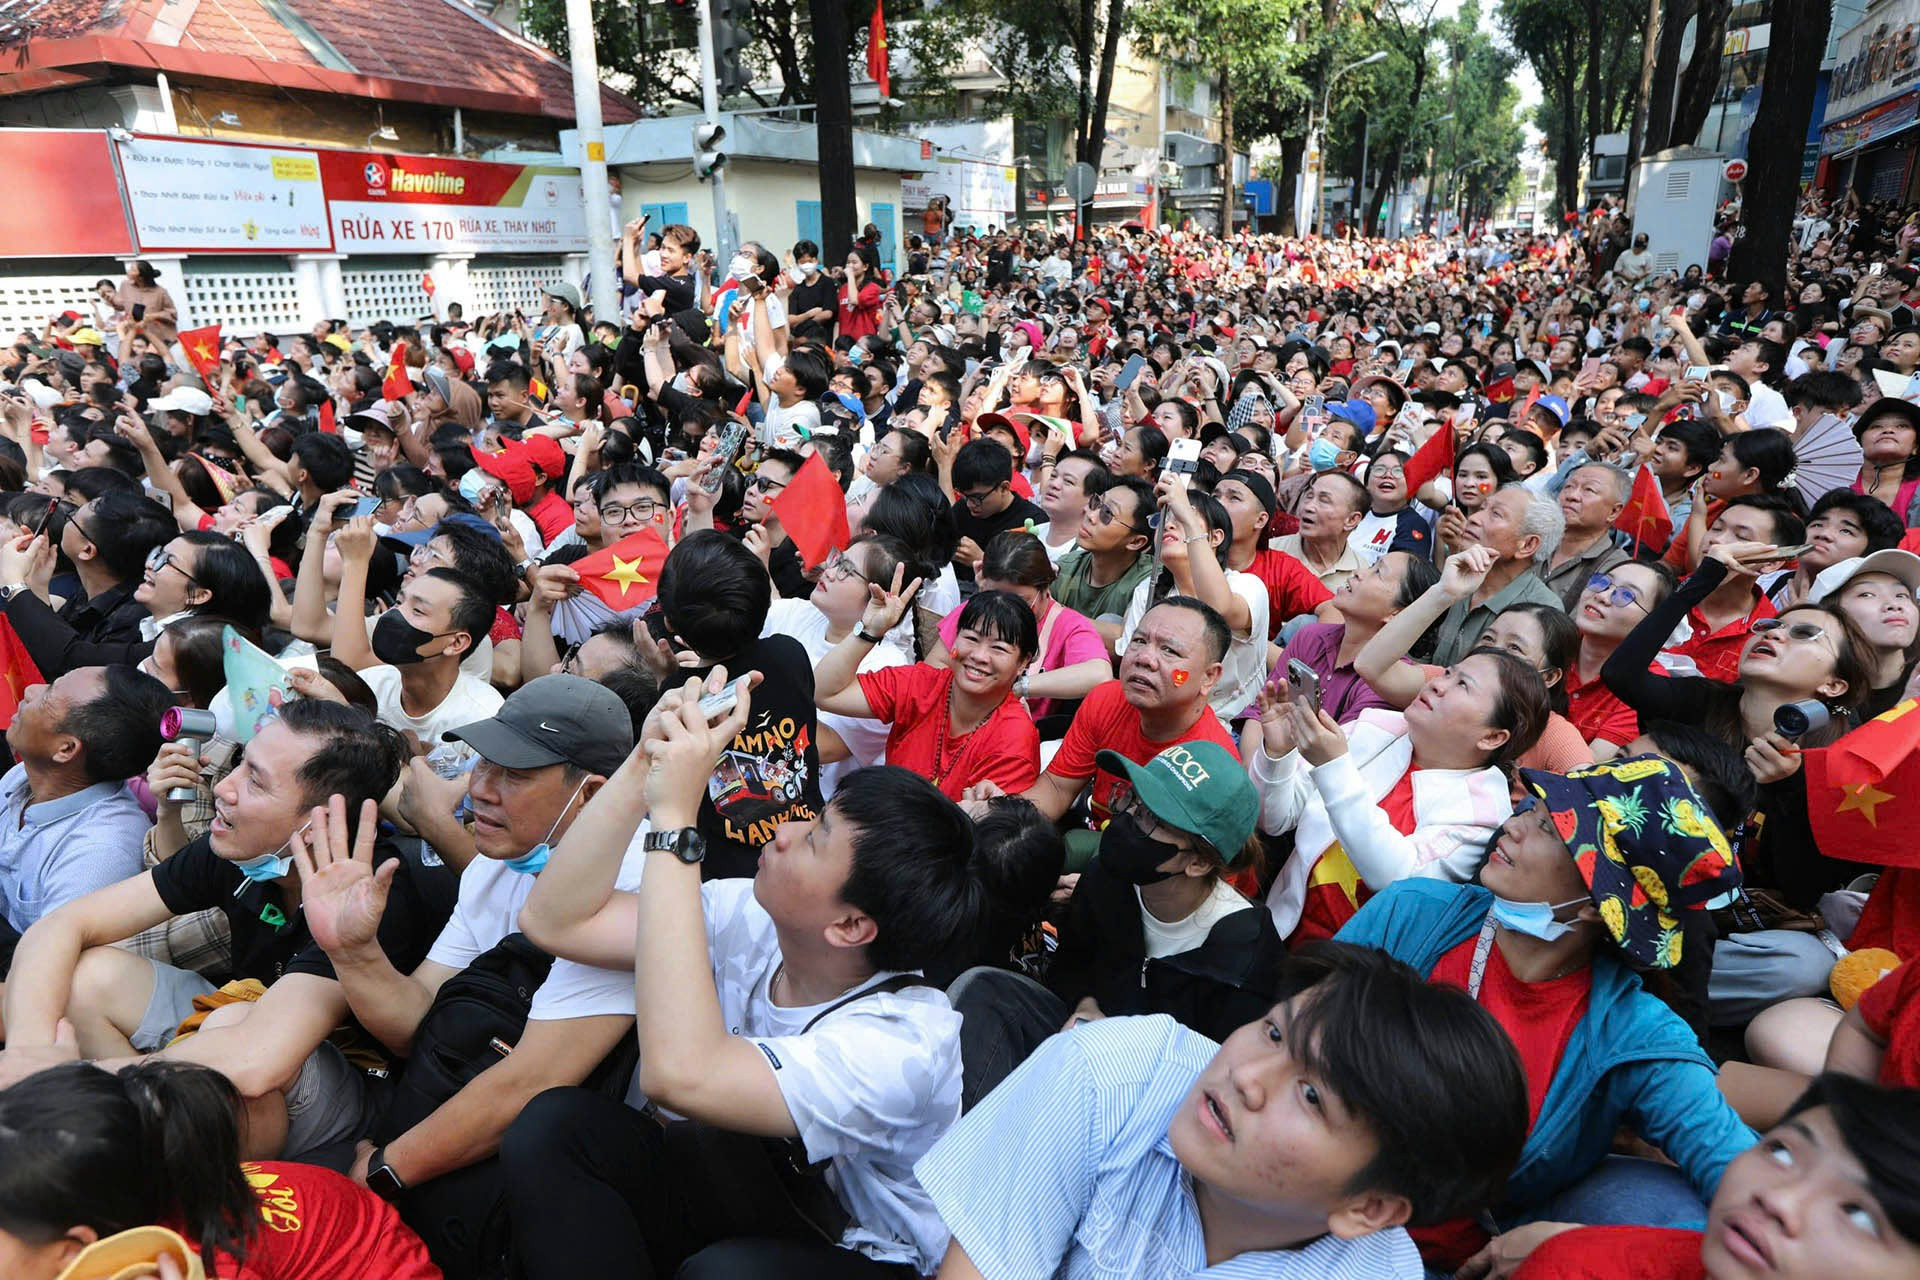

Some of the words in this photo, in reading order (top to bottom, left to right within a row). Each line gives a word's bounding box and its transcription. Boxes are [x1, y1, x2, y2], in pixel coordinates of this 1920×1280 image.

[391, 168, 465, 195] Havoline
[391, 220, 416, 240] XE
[421, 221, 454, 241] 170
[503, 221, 529, 233] THAY
[1371, 528, 1392, 544] H
[1158, 745, 1211, 788] UCCI
